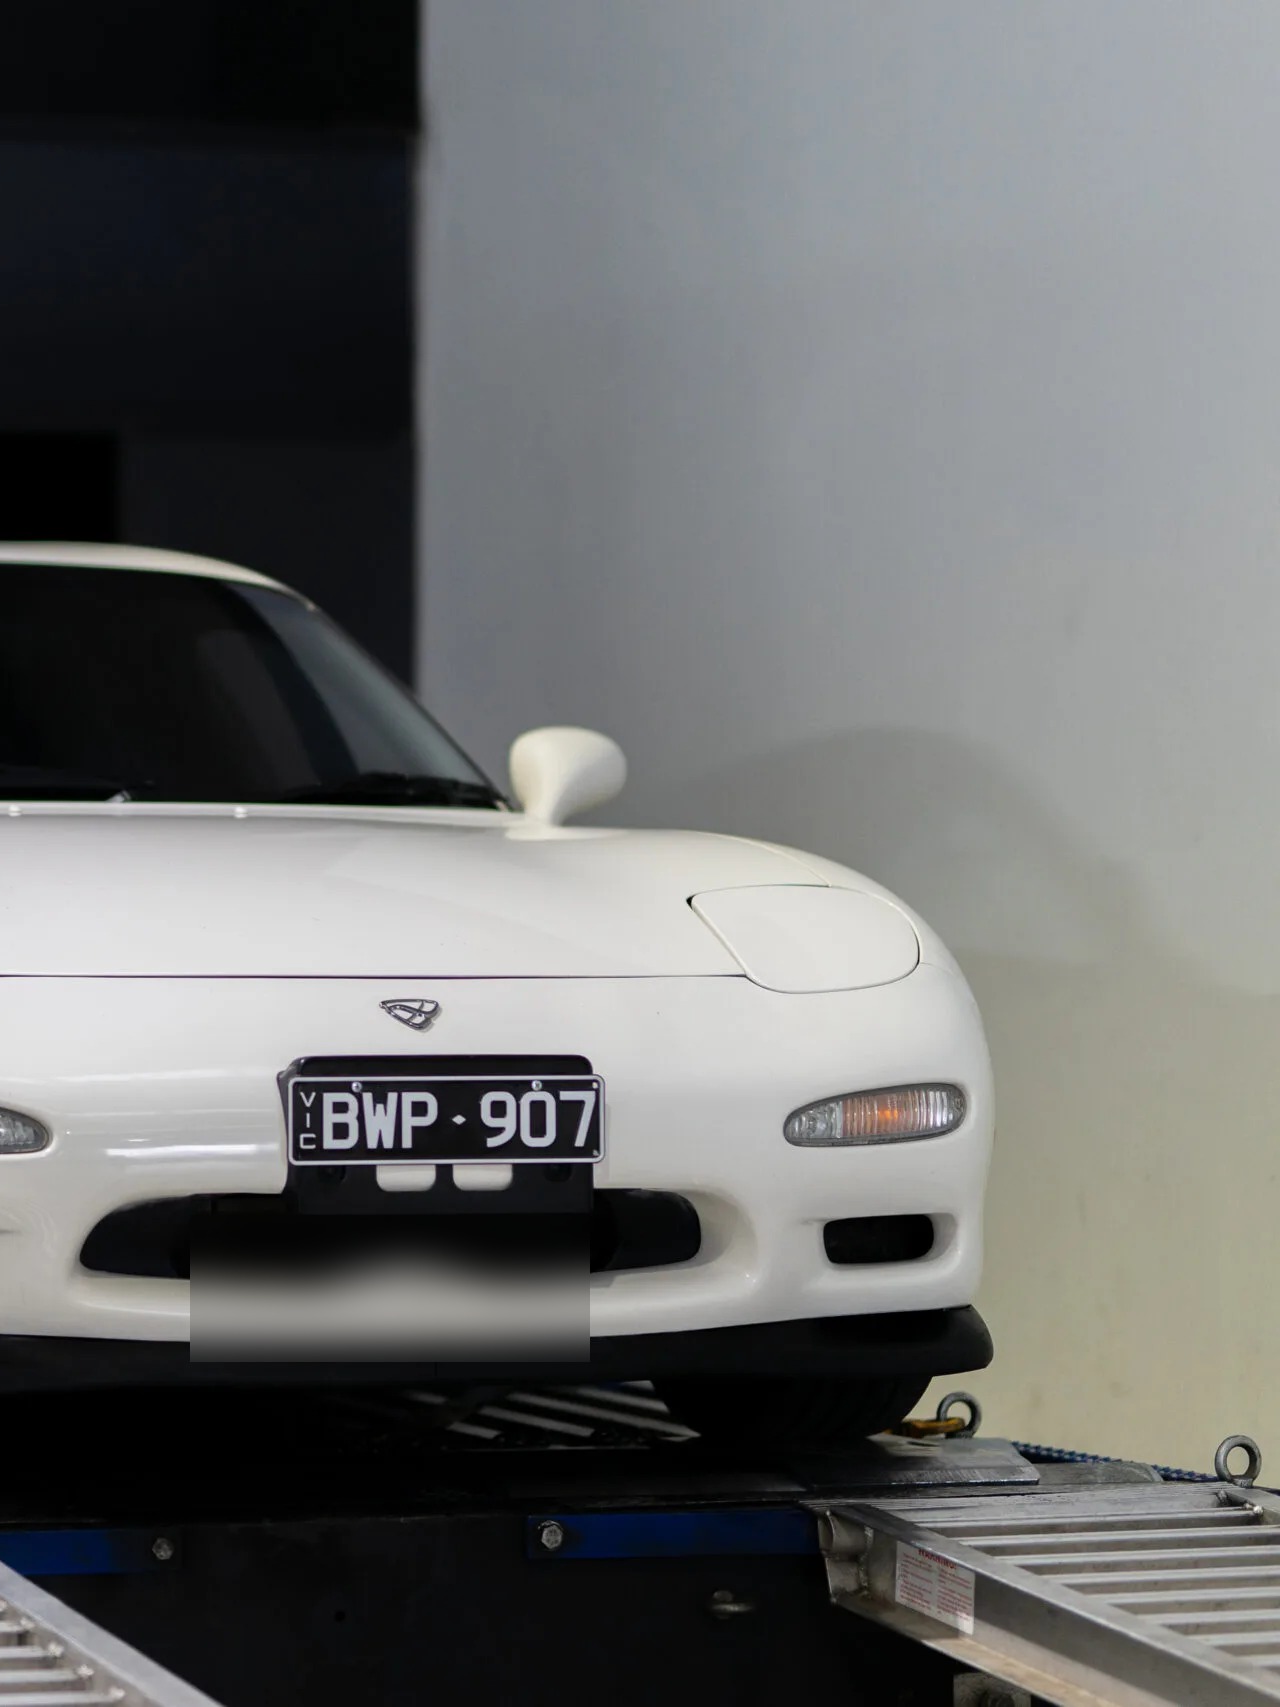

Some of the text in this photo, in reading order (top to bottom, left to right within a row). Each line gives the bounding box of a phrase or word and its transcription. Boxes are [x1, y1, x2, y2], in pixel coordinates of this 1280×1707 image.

[299, 1091, 317, 1150] VIC
[322, 1090, 597, 1150] BWP 907
